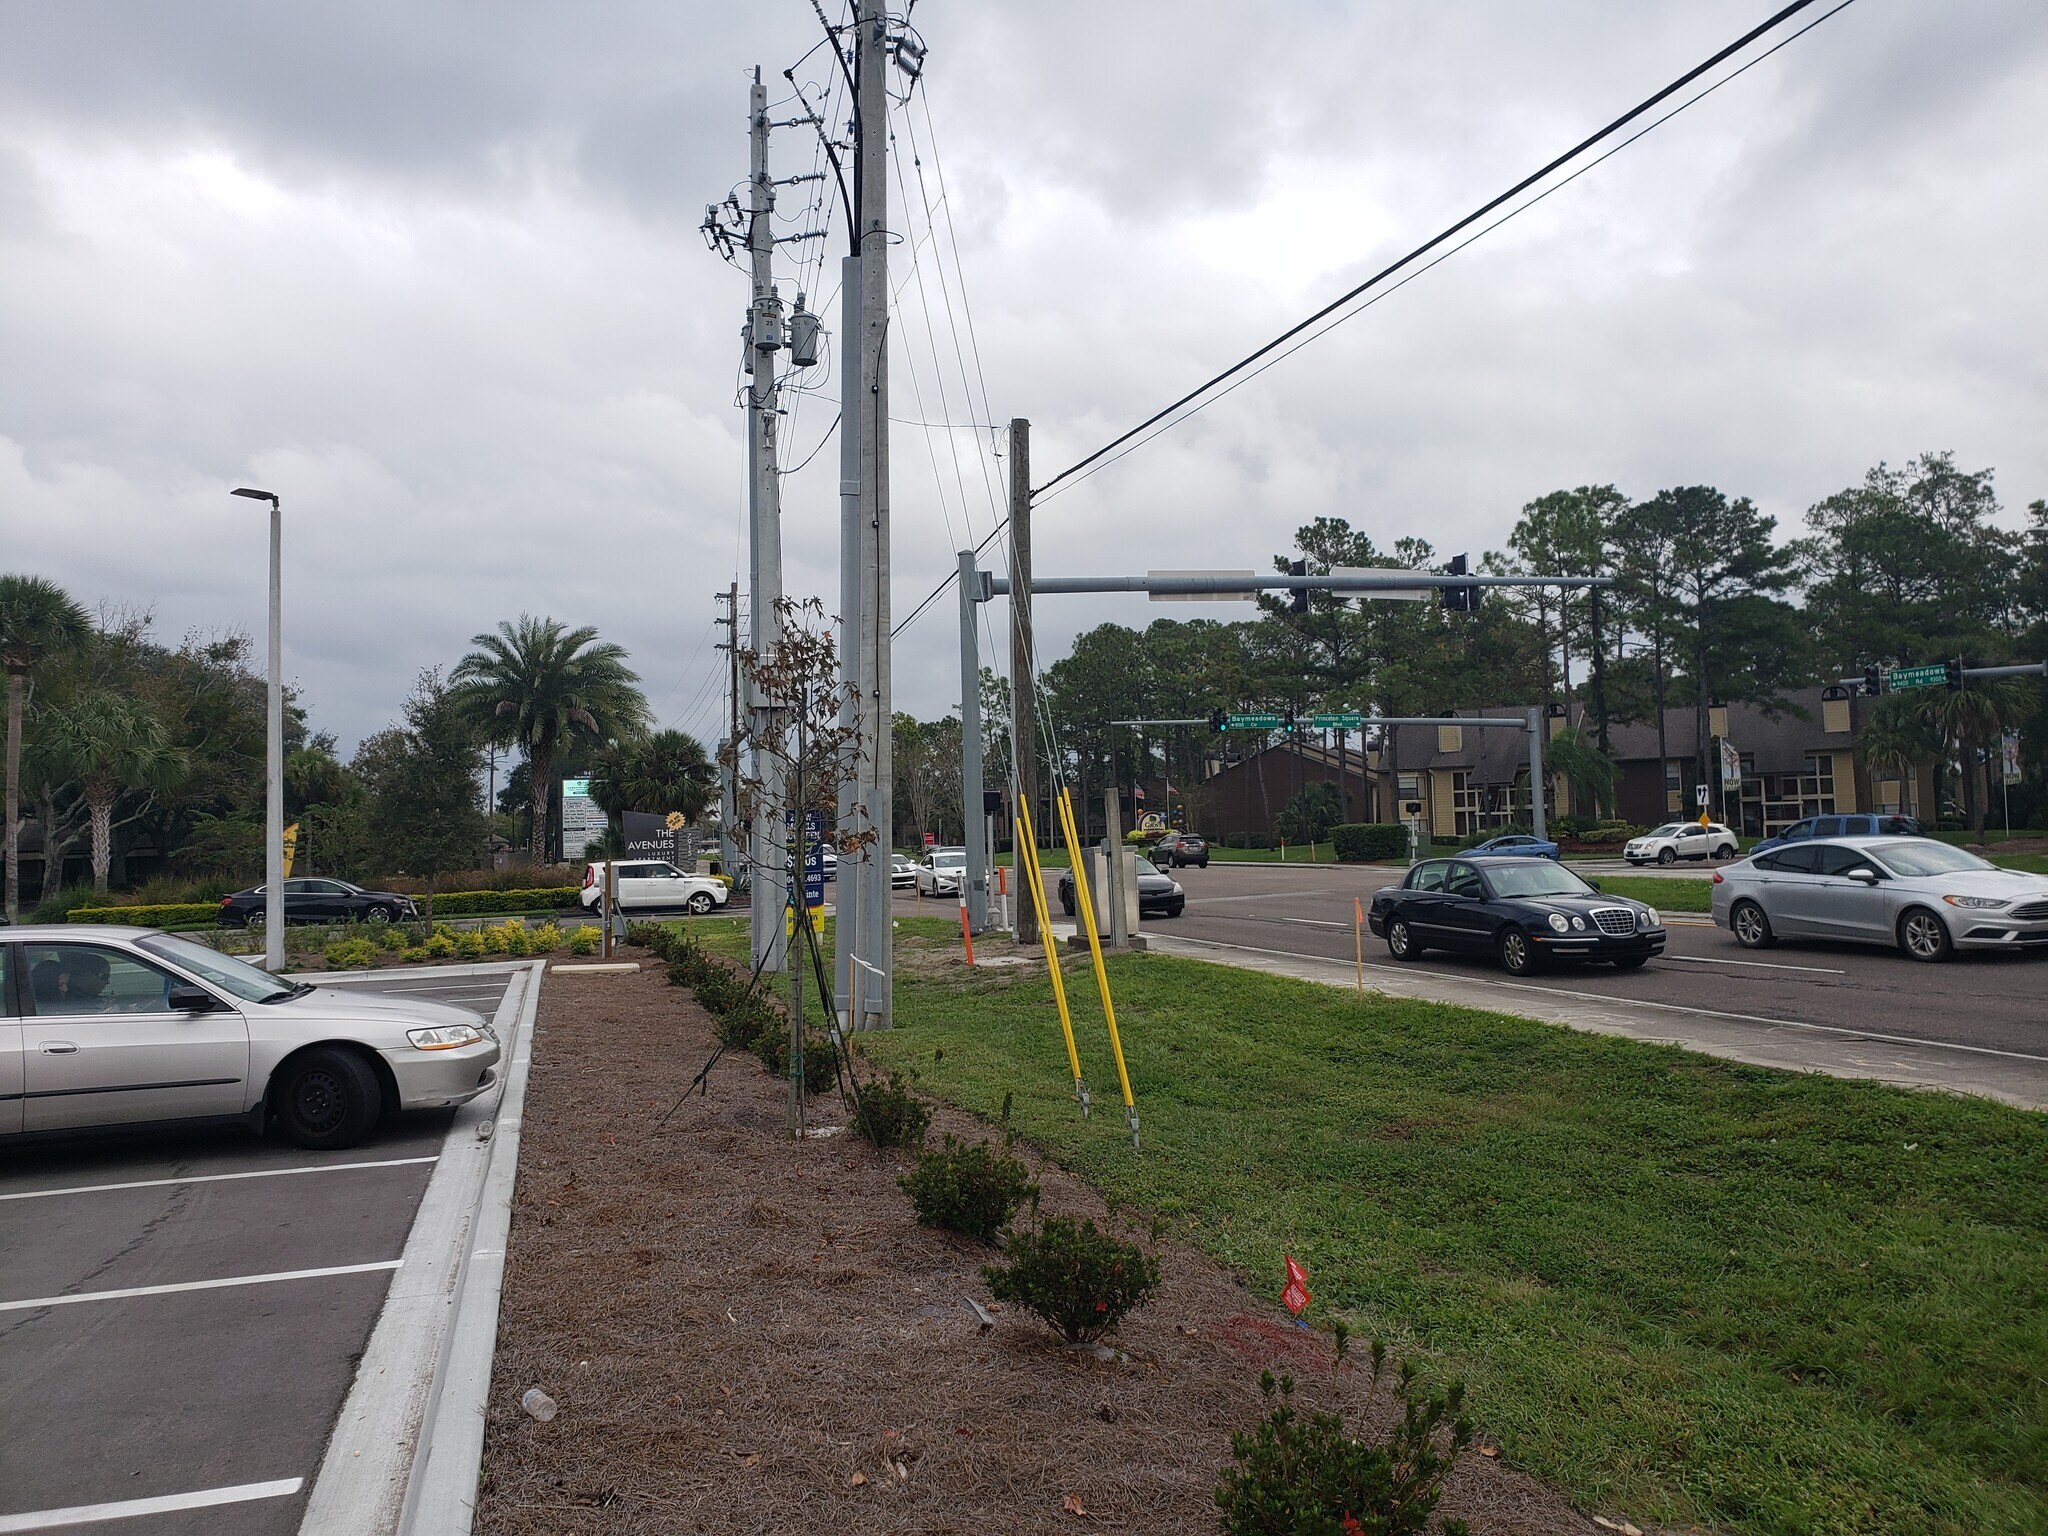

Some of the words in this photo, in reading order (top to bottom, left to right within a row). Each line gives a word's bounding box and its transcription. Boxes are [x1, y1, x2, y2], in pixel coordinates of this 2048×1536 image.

[1892, 668, 1945, 680] Baymeadows
[1723, 778, 1740, 786] NOW
[655, 829, 675, 838] THE
[627, 839, 675, 851] AVENUES
